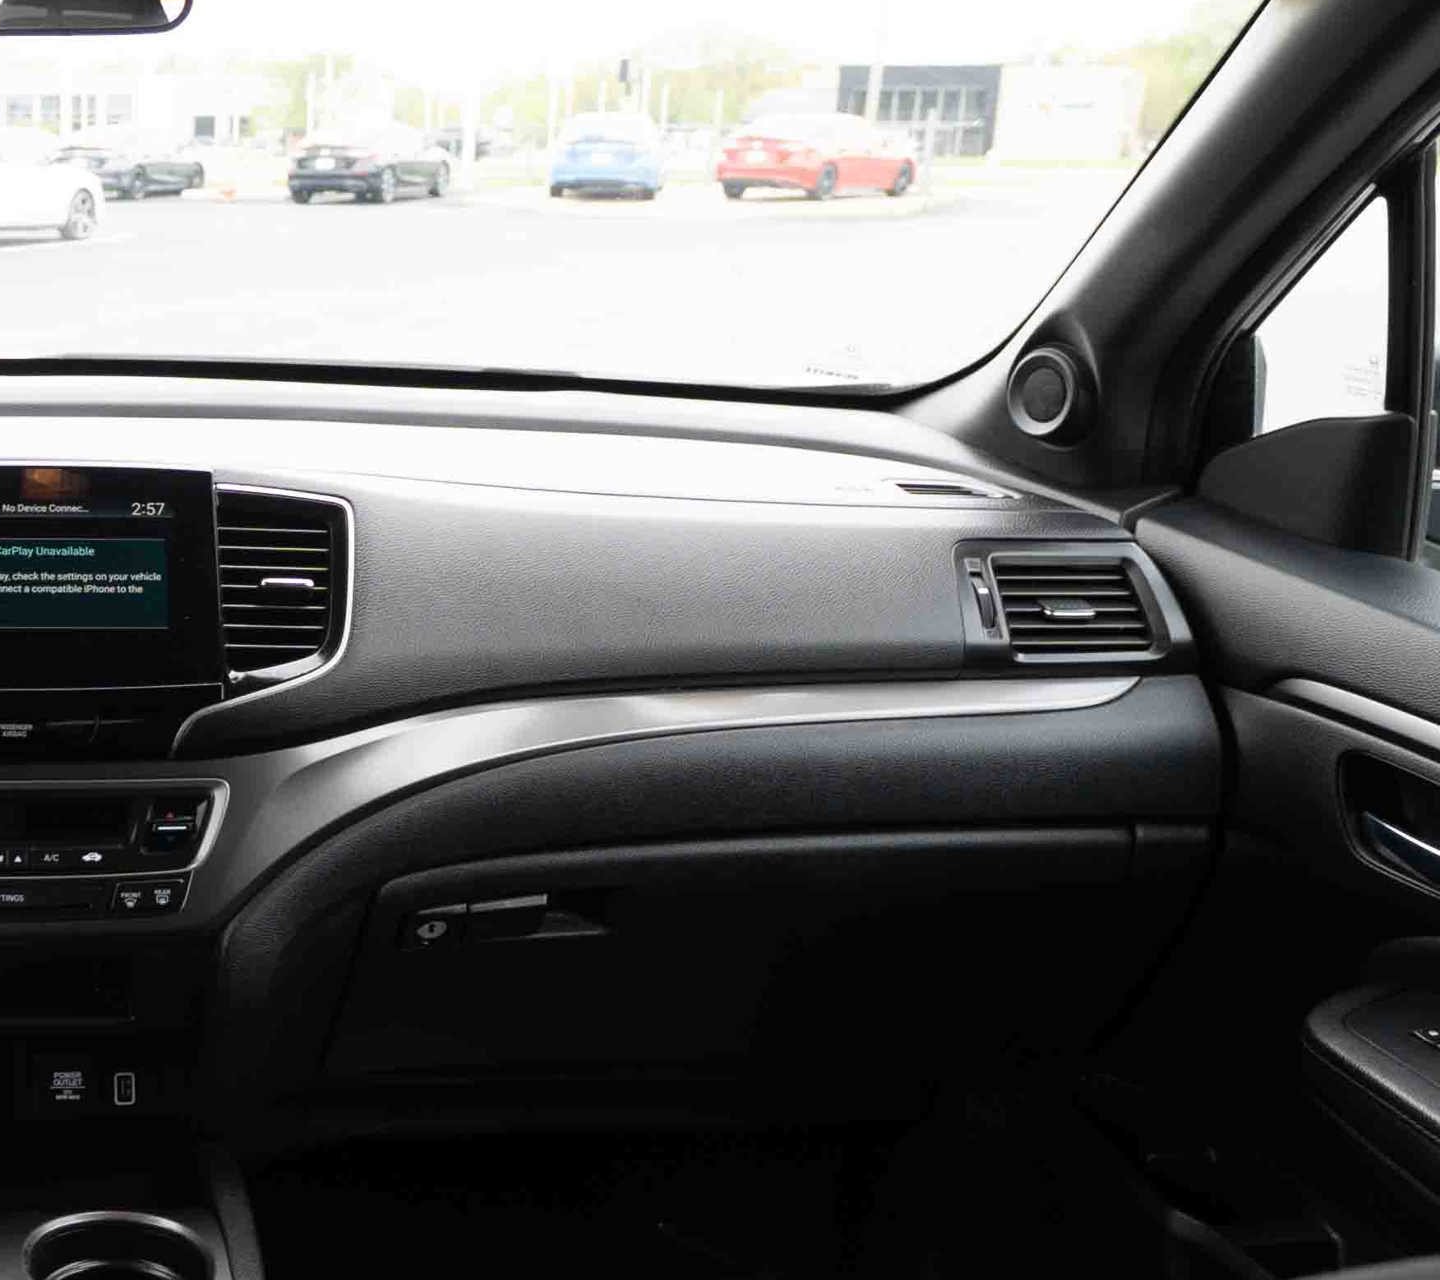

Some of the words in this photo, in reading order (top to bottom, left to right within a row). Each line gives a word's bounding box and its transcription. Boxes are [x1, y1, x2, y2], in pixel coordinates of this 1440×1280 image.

[1, 502, 16, 514] No
[18, 502, 46, 514] Device
[130, 501, 166, 517] 2:57
[35, 545, 95, 557] Unavailable
[12, 570, 39, 580] check
[40, 570, 56, 580] the
[57, 570, 93, 582] settings
[95, 570, 107, 581] on
[108, 570, 128, 582] your
[129, 570, 162, 581] vehicle
[31, 583, 82, 595] compatible
[84, 583, 115, 593] iPhone
[116, 583, 126, 593] to
[127, 583, 143, 593] the
[43, 853, 60, 862] A/C
[52, 1078, 83, 1087] OUTLET
